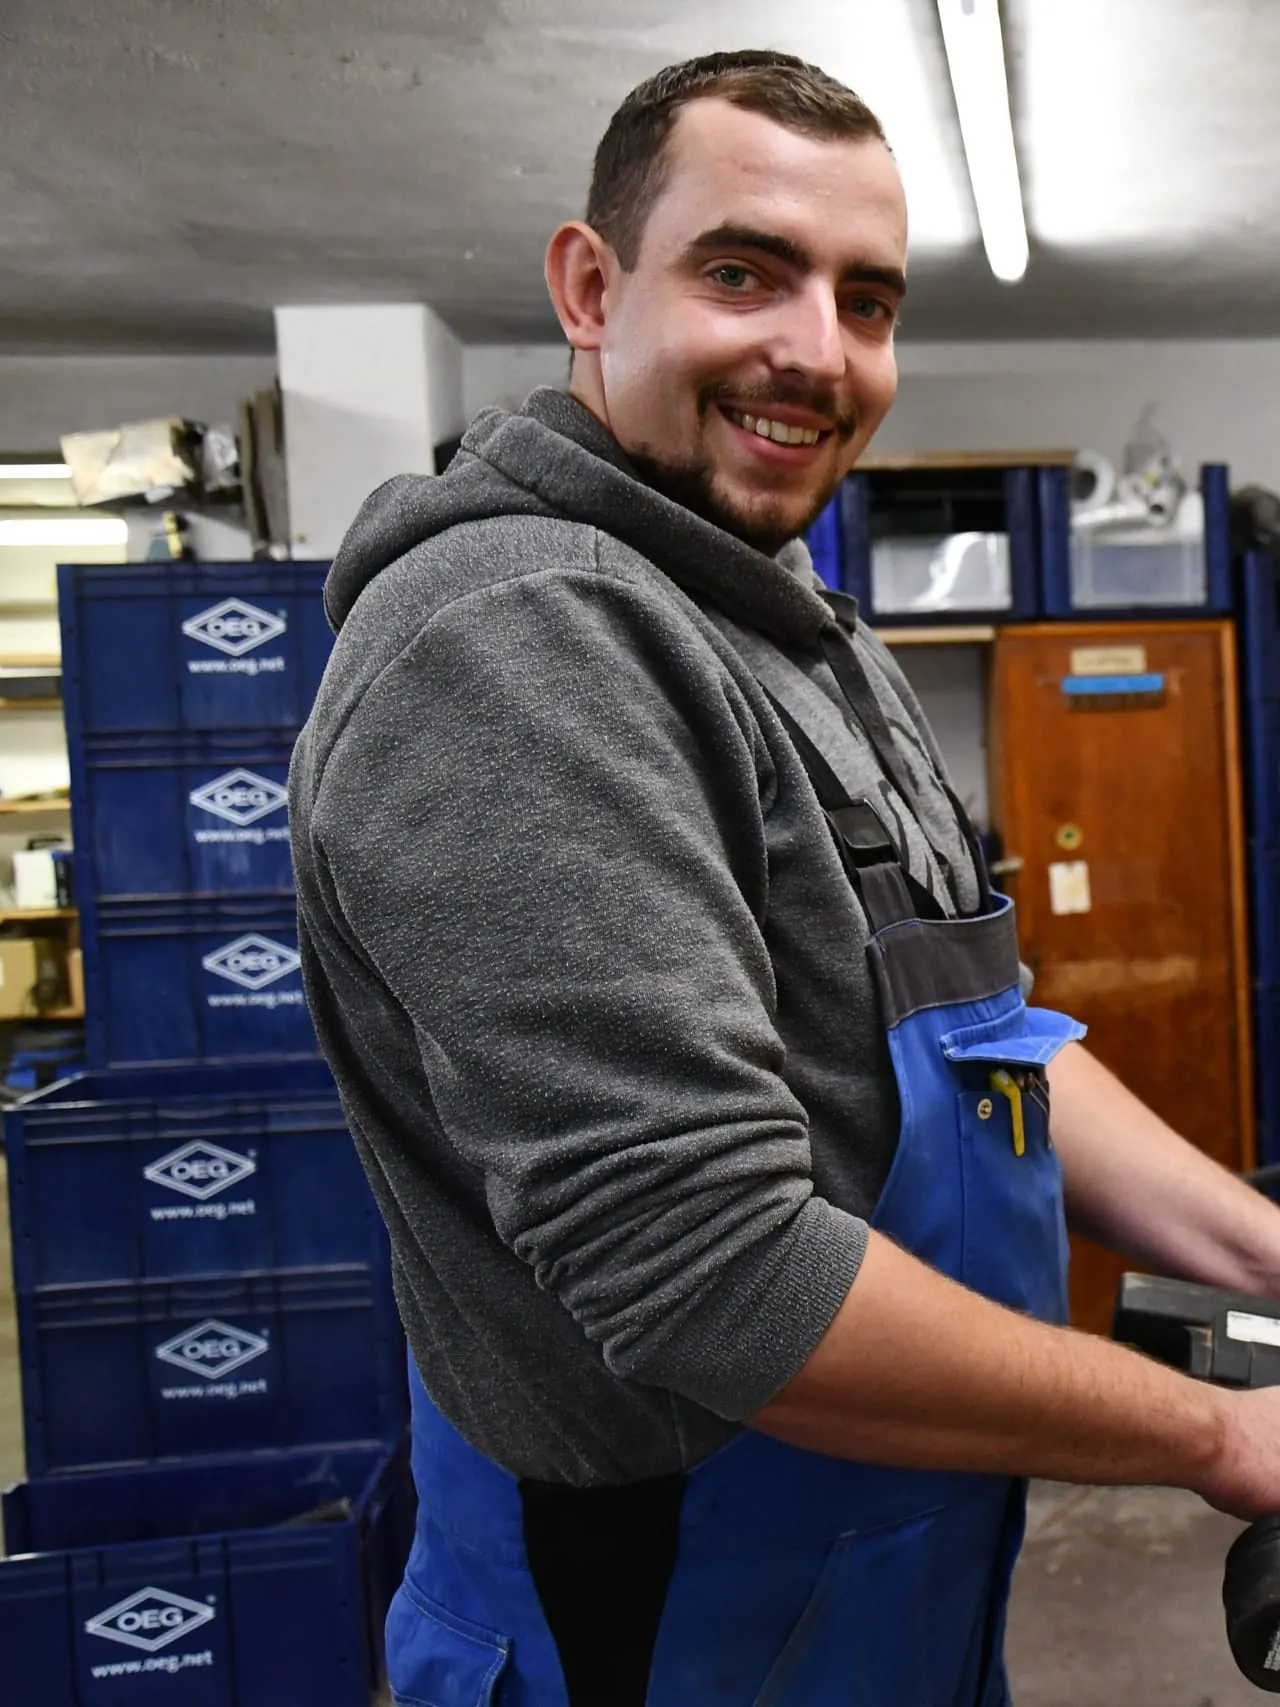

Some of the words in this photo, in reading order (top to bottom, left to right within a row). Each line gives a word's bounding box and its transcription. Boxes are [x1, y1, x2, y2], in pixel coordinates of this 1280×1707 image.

[207, 617, 261, 639] OEG
[187, 656, 285, 676] www.oeg.net
[215, 787, 268, 808] OEG
[226, 951, 280, 971] OEG
[171, 1159, 228, 1181] OEG
[150, 1199, 256, 1221] www.oeg.net
[183, 1338, 241, 1361] OEG
[161, 1378, 267, 1400] www.oeg.net
[117, 1606, 183, 1632] OEG
[90, 1650, 213, 1679] www.oeg.net
